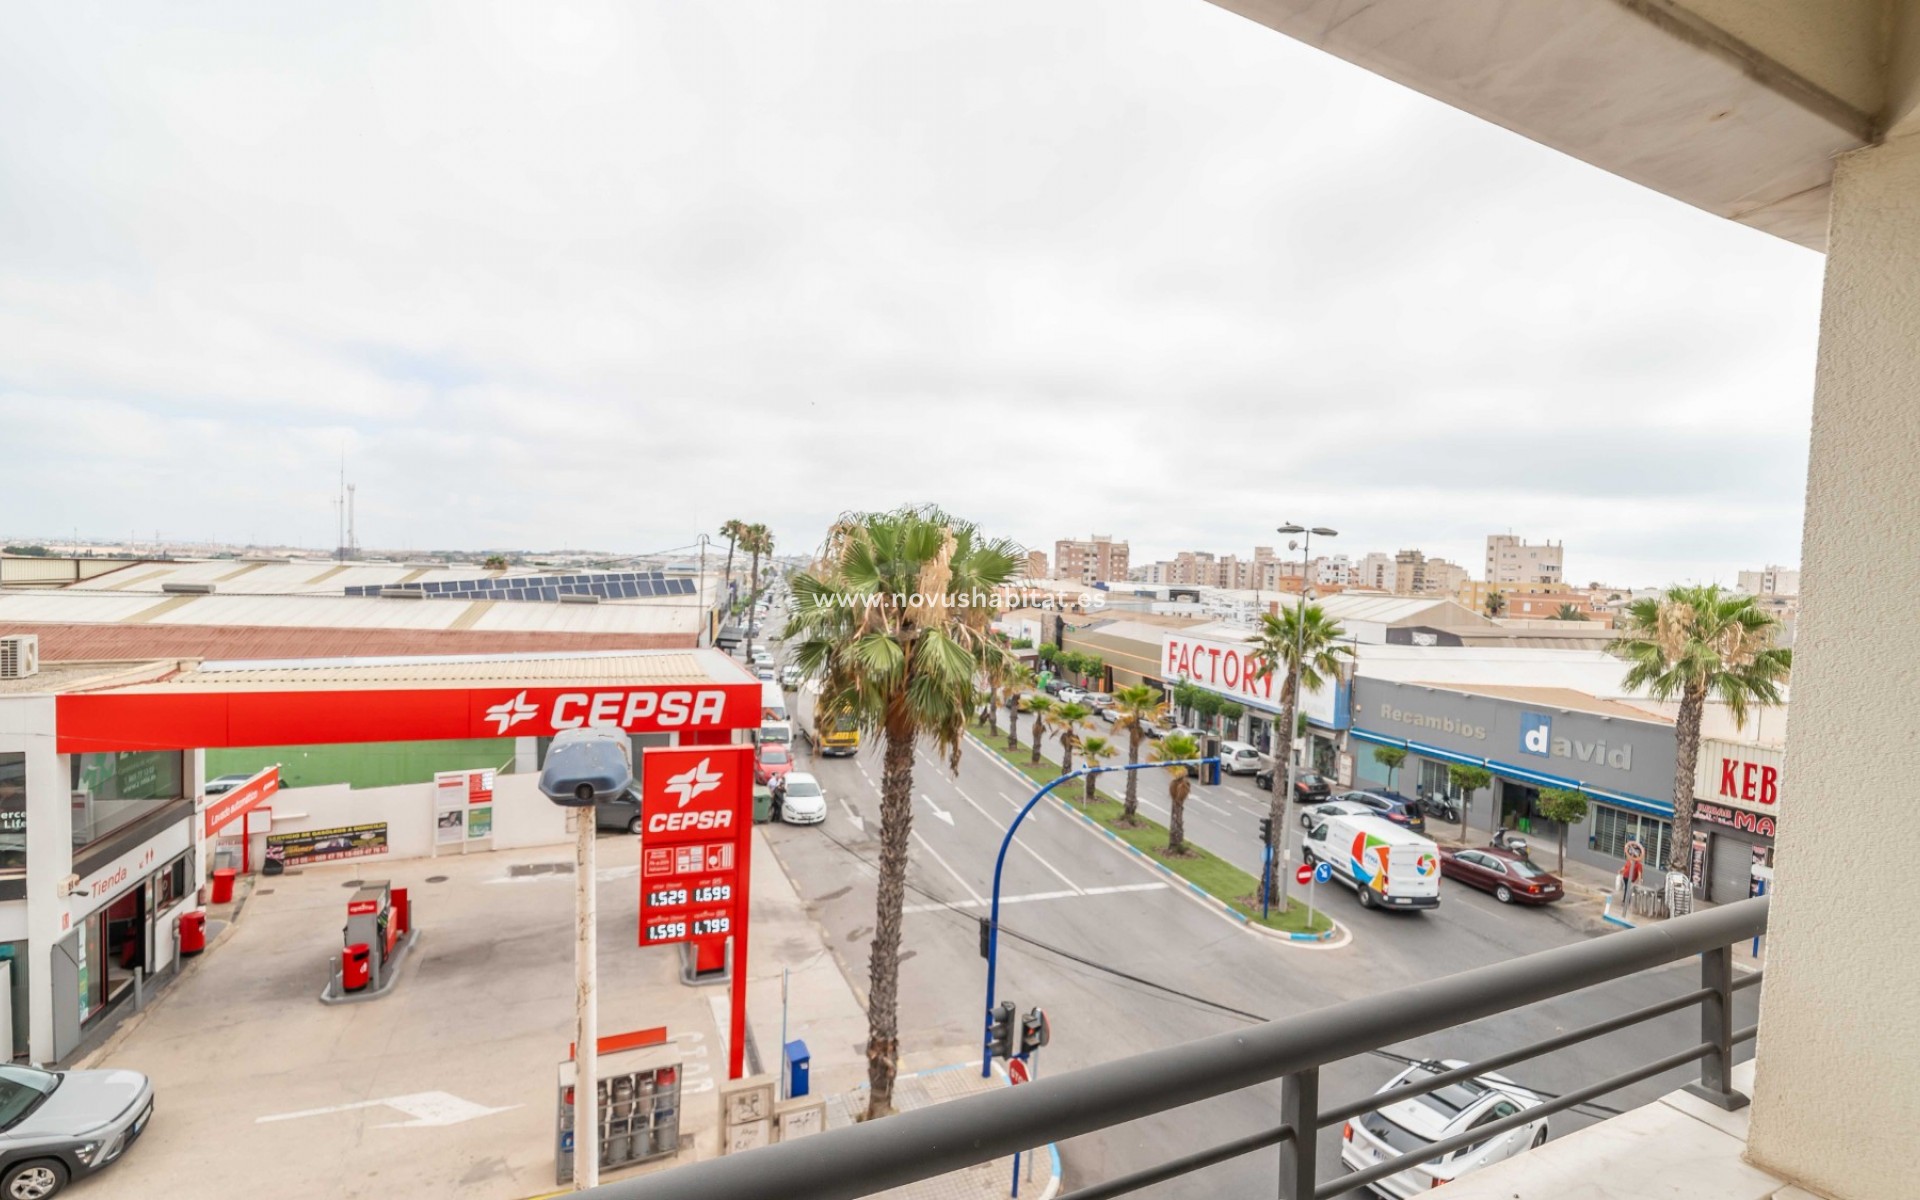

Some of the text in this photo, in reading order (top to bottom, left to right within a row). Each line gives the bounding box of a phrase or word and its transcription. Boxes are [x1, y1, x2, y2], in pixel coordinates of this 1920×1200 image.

[1168, 641, 1273, 698] FACTORY
[550, 690, 726, 729] CEPSA
[1380, 704, 1633, 771] Recambios david
[648, 809, 732, 833] CEPSA
[91, 867, 127, 898] Tienda
[650, 889, 687, 906] 1.529
[695, 885, 731, 902] 1.699
[649, 922, 686, 940] 1.599
[694, 917, 730, 935] 1.799
[1010, 1067, 1025, 1084] STO
